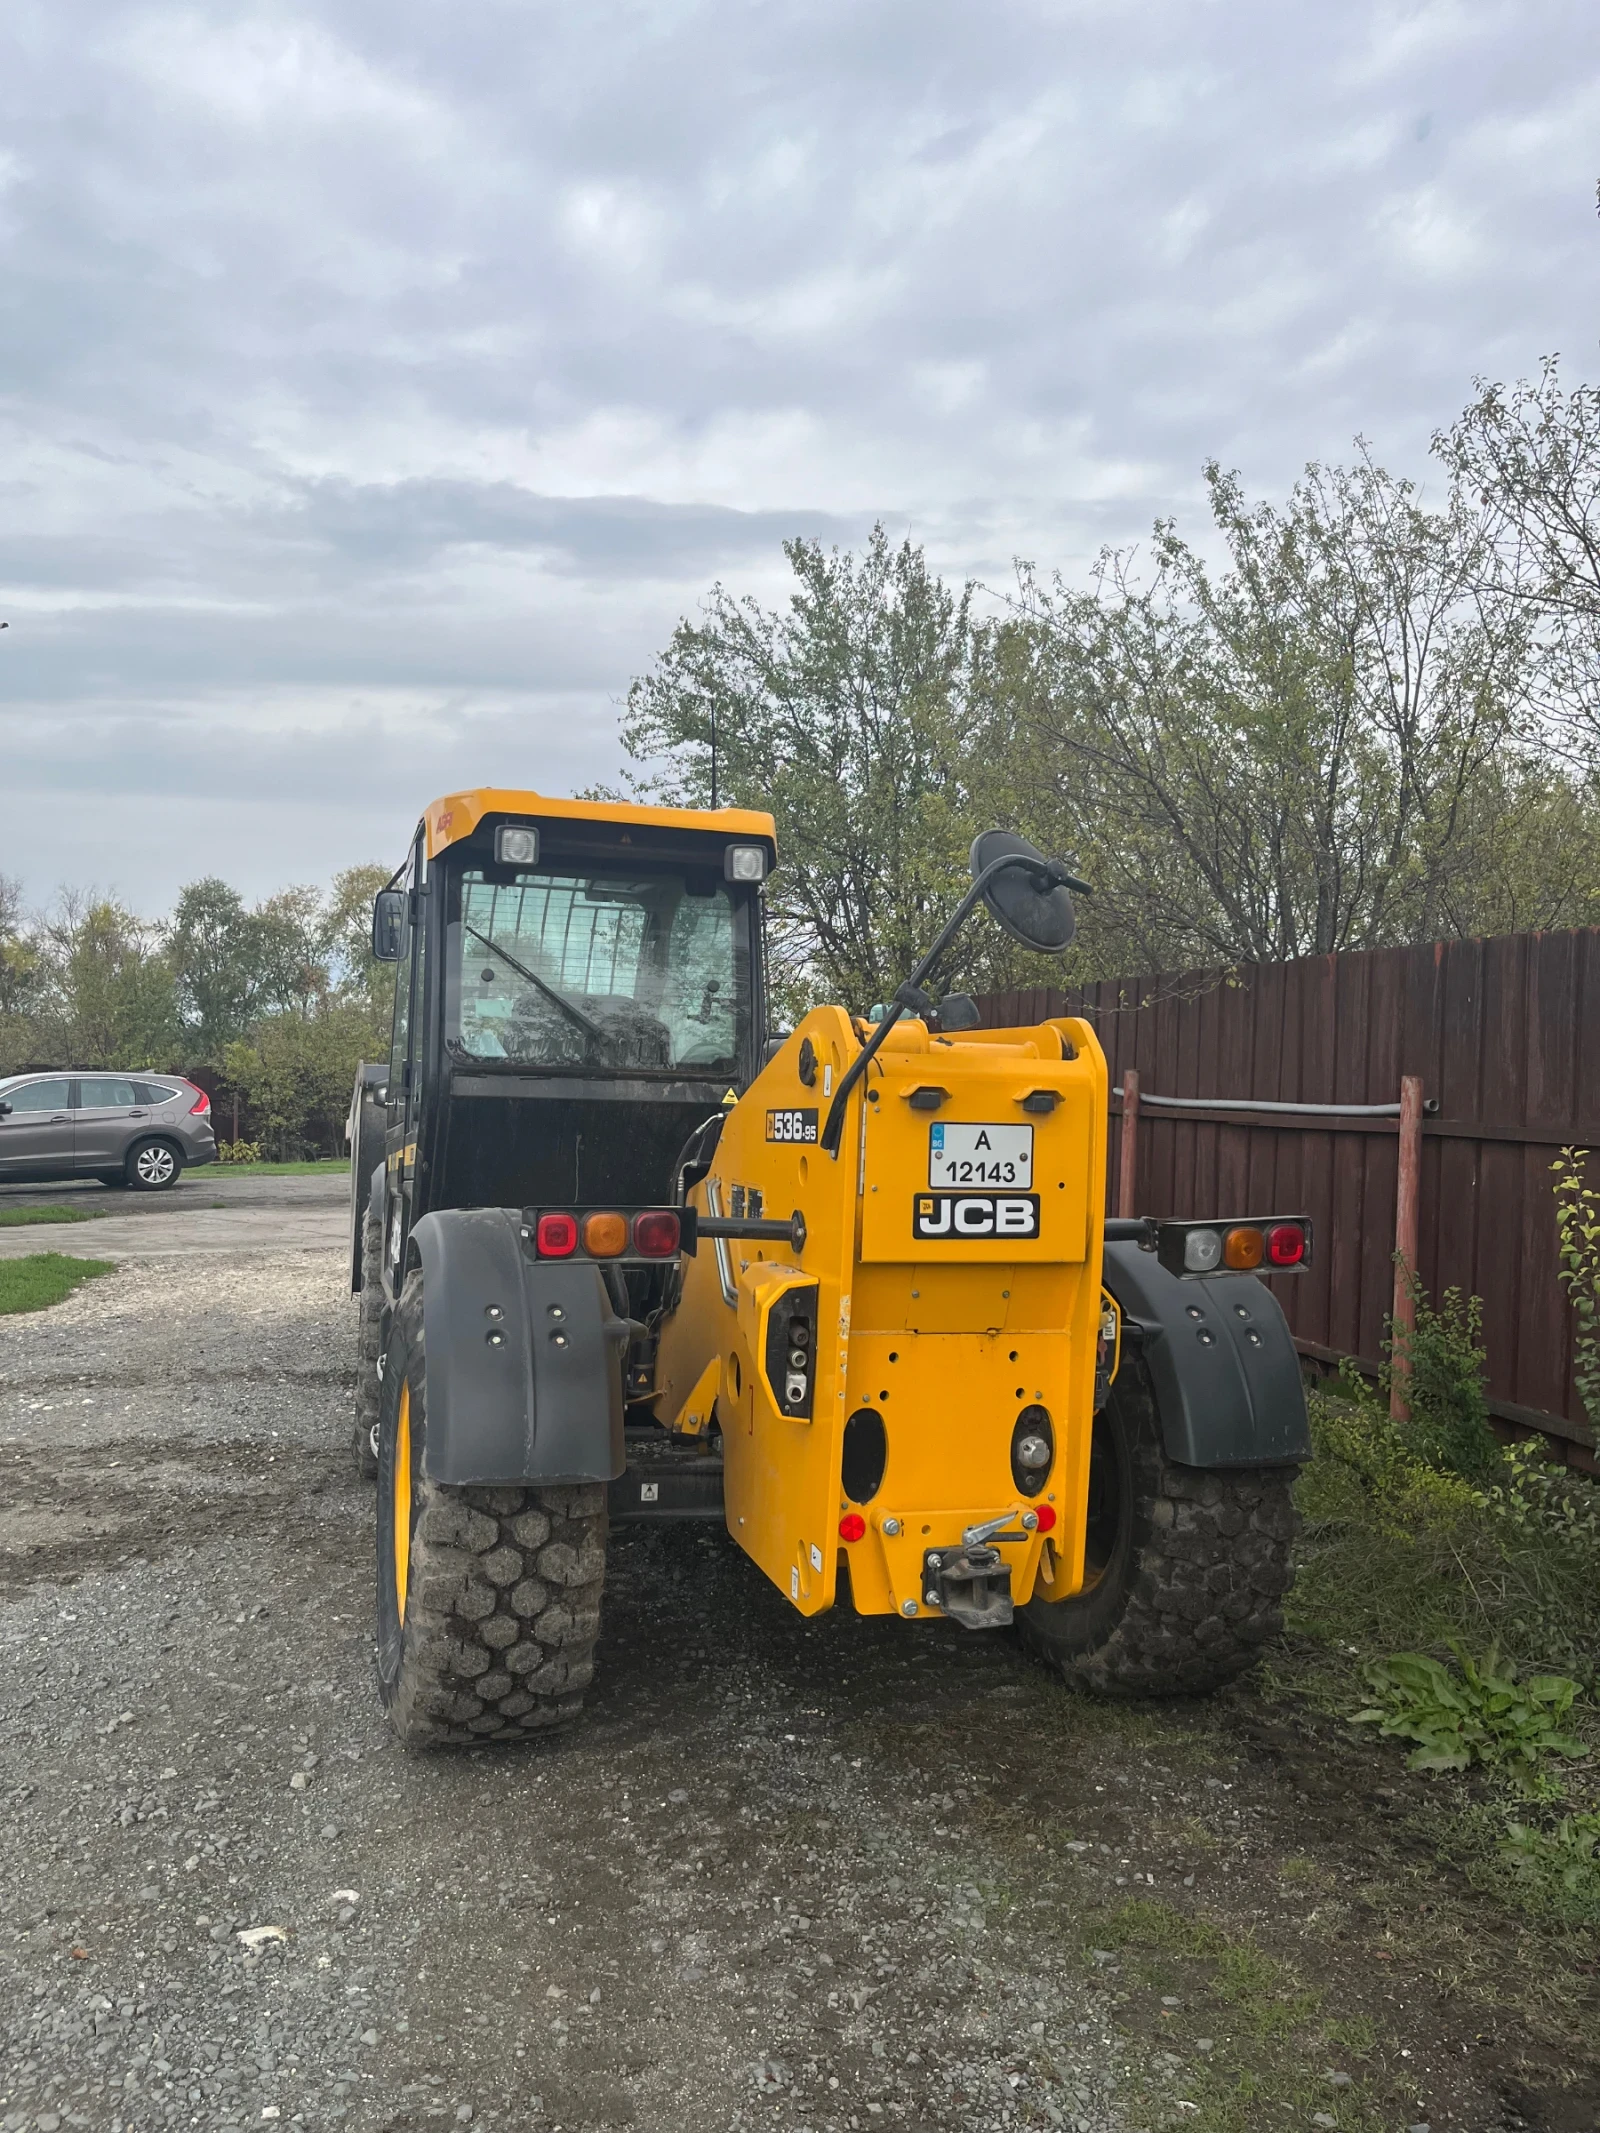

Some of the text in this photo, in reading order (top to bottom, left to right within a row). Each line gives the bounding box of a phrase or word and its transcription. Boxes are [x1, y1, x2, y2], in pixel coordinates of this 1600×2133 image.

[932, 1140, 943, 1148] BG
[974, 1130, 992, 1150] A
[946, 1161, 1016, 1183] 12143
[919, 1199, 1035, 1233] JCB
